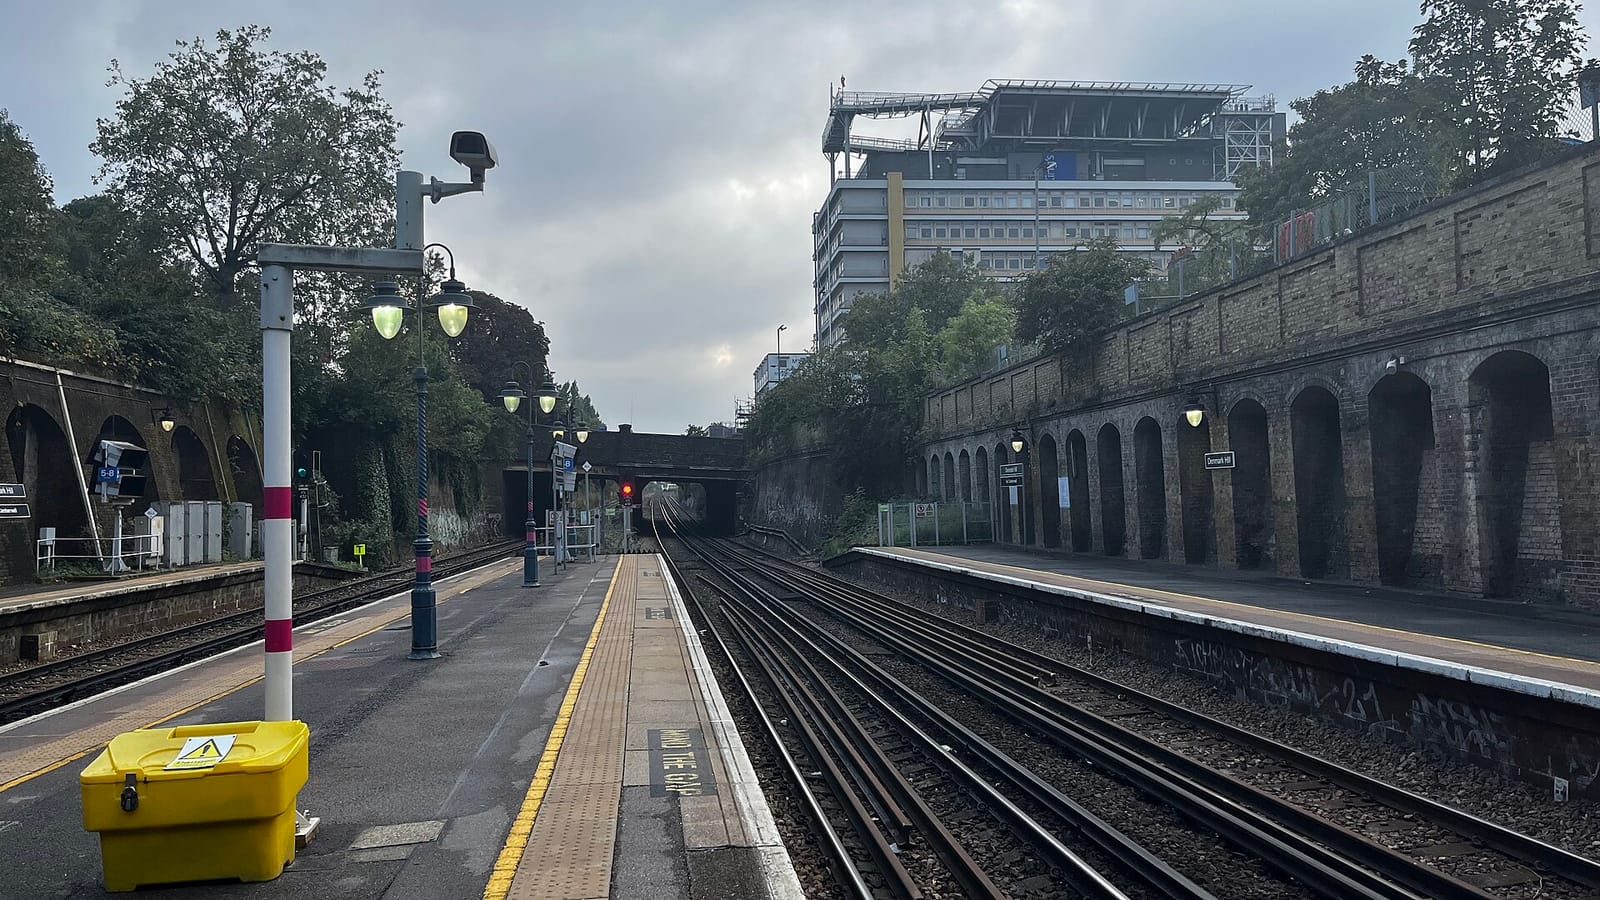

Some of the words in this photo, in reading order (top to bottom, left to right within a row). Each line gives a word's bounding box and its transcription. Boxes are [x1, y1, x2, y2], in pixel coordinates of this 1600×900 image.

[1044, 155, 1057, 180] ing's
[101, 469, 114, 477] 5-8
[661, 729, 691, 748] MIND
[663, 752, 697, 769] THE
[664, 774, 702, 796] GAP
